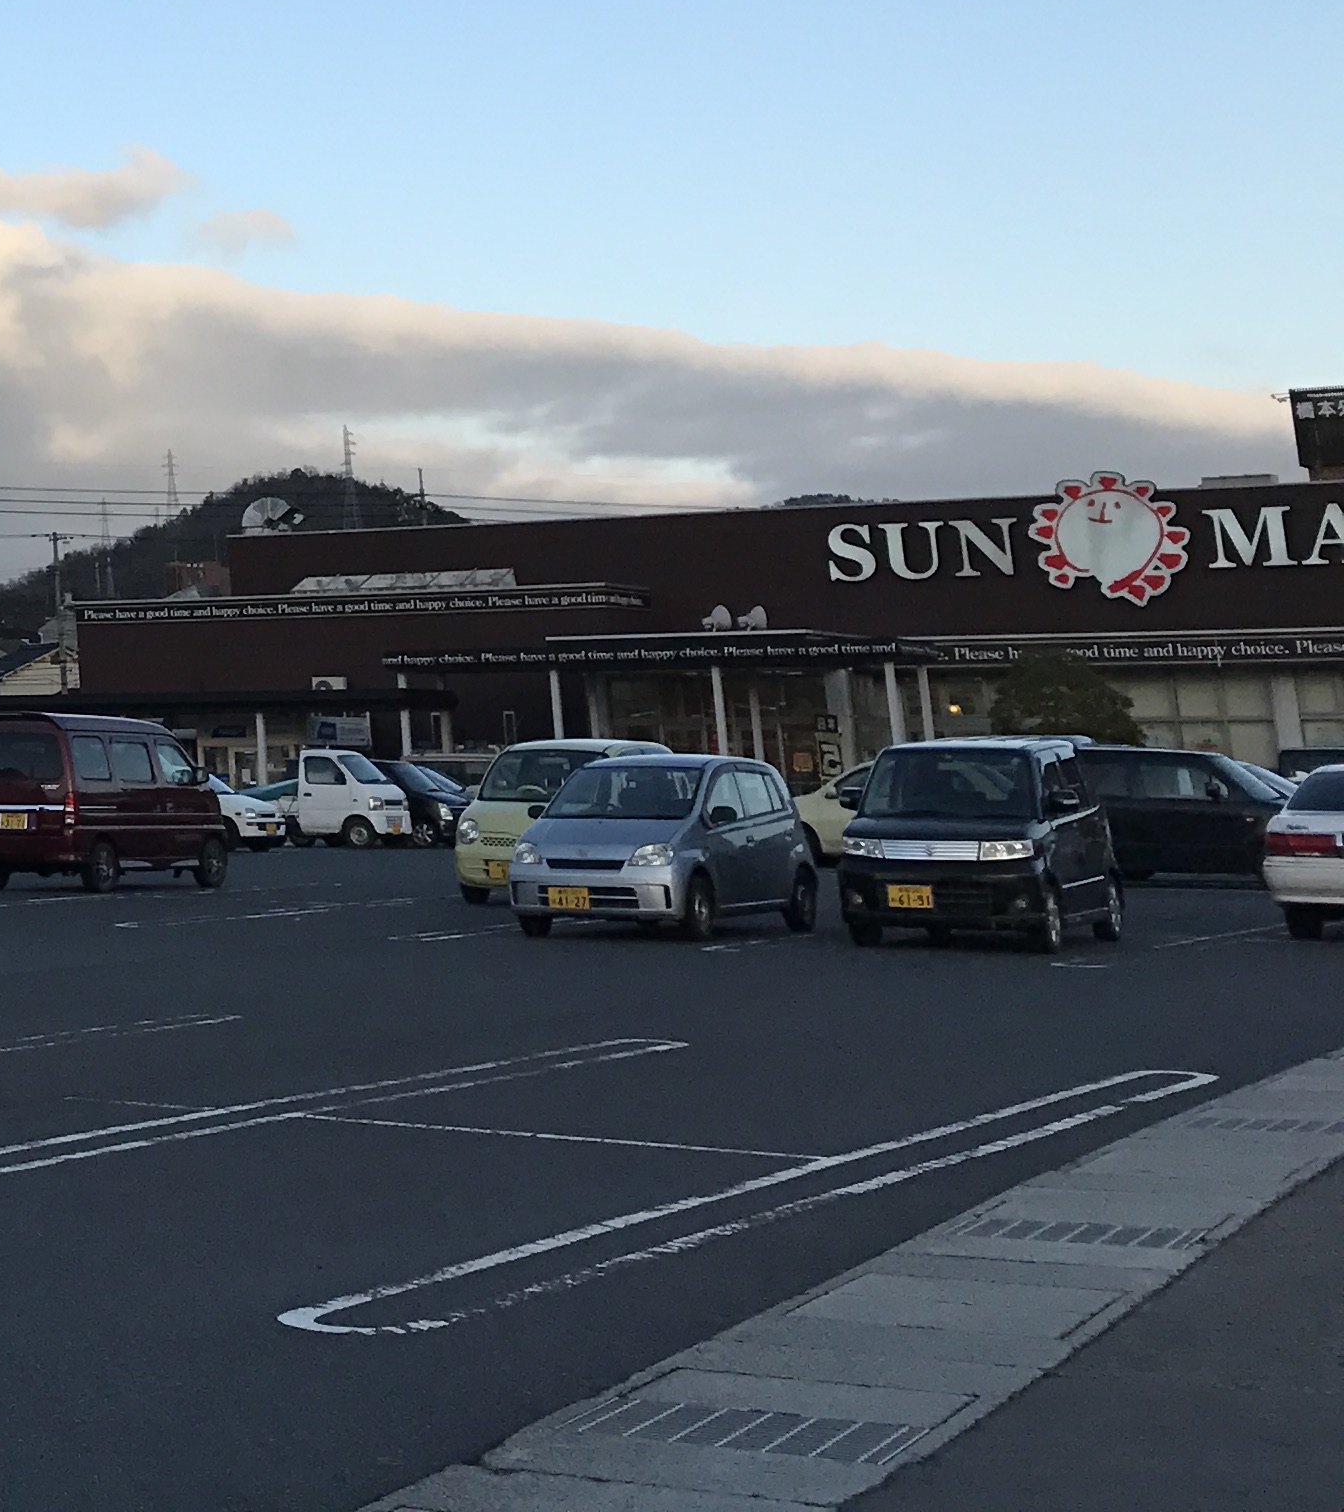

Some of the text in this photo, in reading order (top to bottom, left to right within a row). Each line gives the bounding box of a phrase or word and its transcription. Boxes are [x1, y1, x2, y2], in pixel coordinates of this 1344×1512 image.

[827, 518, 1017, 582] SUN
[84, 608, 114, 620] Please
[115, 608, 137, 619] have
[138, 610, 145, 618] a
[146, 607, 169, 619] good
[170, 607, 192, 618] time
[192, 606, 212, 617] and
[212, 605, 242, 618] happy
[278, 603, 310, 614] Please
[312, 602, 335, 613] have
[336, 604, 343, 612] a
[345, 600, 369, 613] good
[370, 600, 394, 611] time
[395, 599, 415, 610] and
[416, 599, 447, 611] happy
[488, 596, 523, 607] Please
[524, 594, 550, 605] have
[551, 596, 559, 604] a
[561, 592, 587, 605] good
[404, 654, 437, 666] happy
[481, 652, 518, 663] Please
[520, 651, 547, 662] have
[558, 650, 586, 663] good
[587, 650, 614, 660] time
[616, 649, 640, 660] and
[641, 648, 678, 660] happy
[723, 645, 764, 657] Please
[767, 645, 793, 656] have
[808, 643, 839, 657] good
[841, 643, 871, 654] time
[872, 642, 896, 653] and
[954, 645, 1005, 660] Please
[1103, 643, 1140, 658] time
[1143, 642, 1175, 657] and
[1176, 643, 1227, 660] happy
[1231, 640, 1290, 656] choice.
[1295, 639, 1344, 655] Pleas
